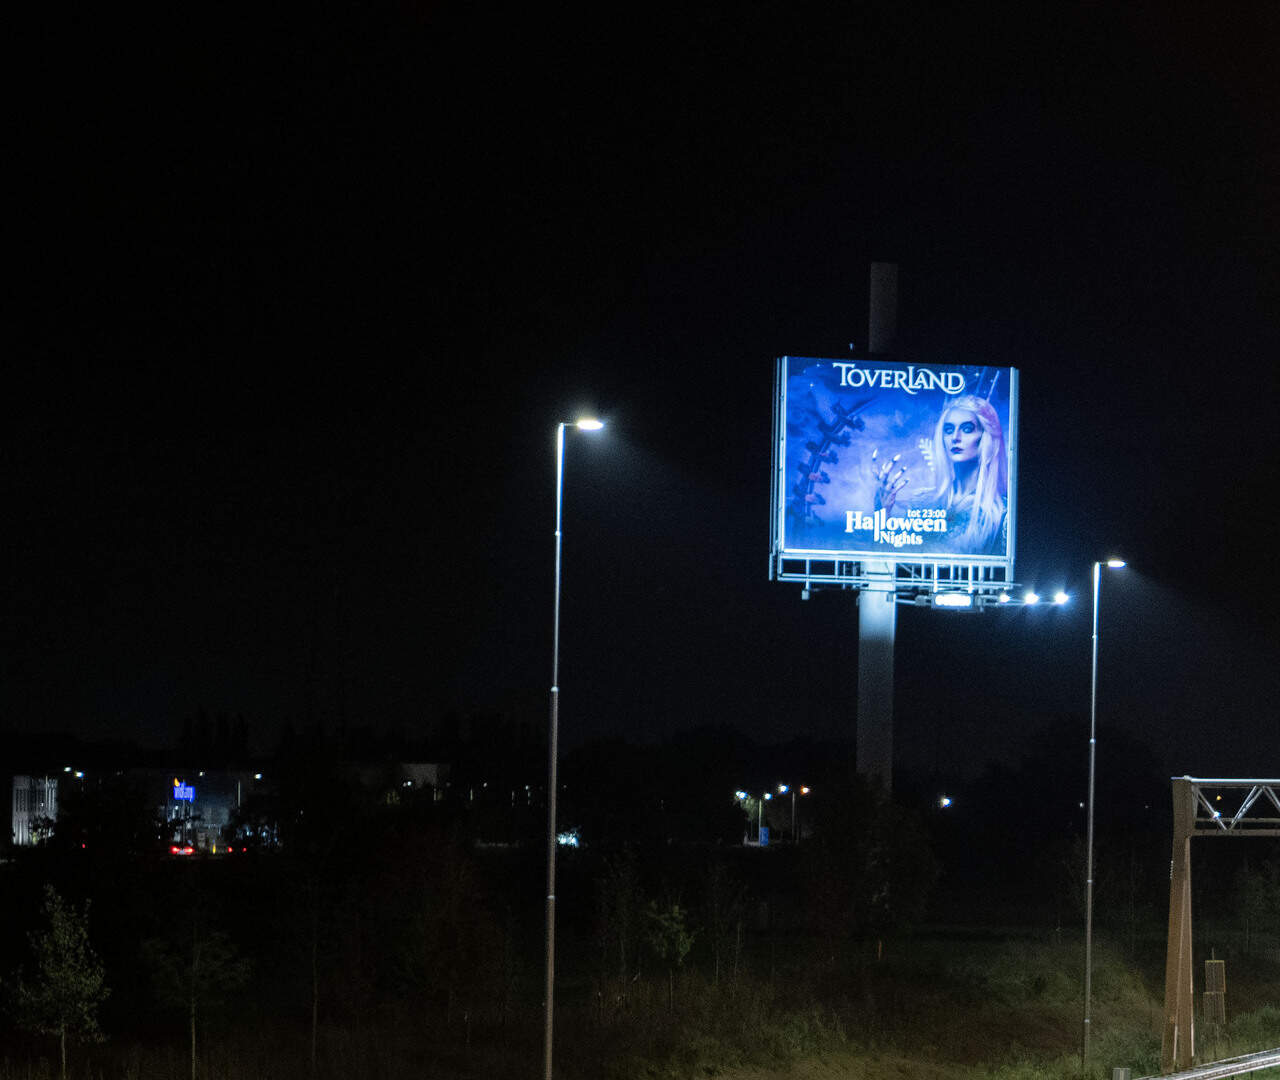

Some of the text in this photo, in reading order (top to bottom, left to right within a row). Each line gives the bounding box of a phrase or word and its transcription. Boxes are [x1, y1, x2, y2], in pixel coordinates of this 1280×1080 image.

[907, 509, 947, 519] tot 23:00
[844, 508, 948, 542] Halloween
[879, 531, 924, 548] Nights
